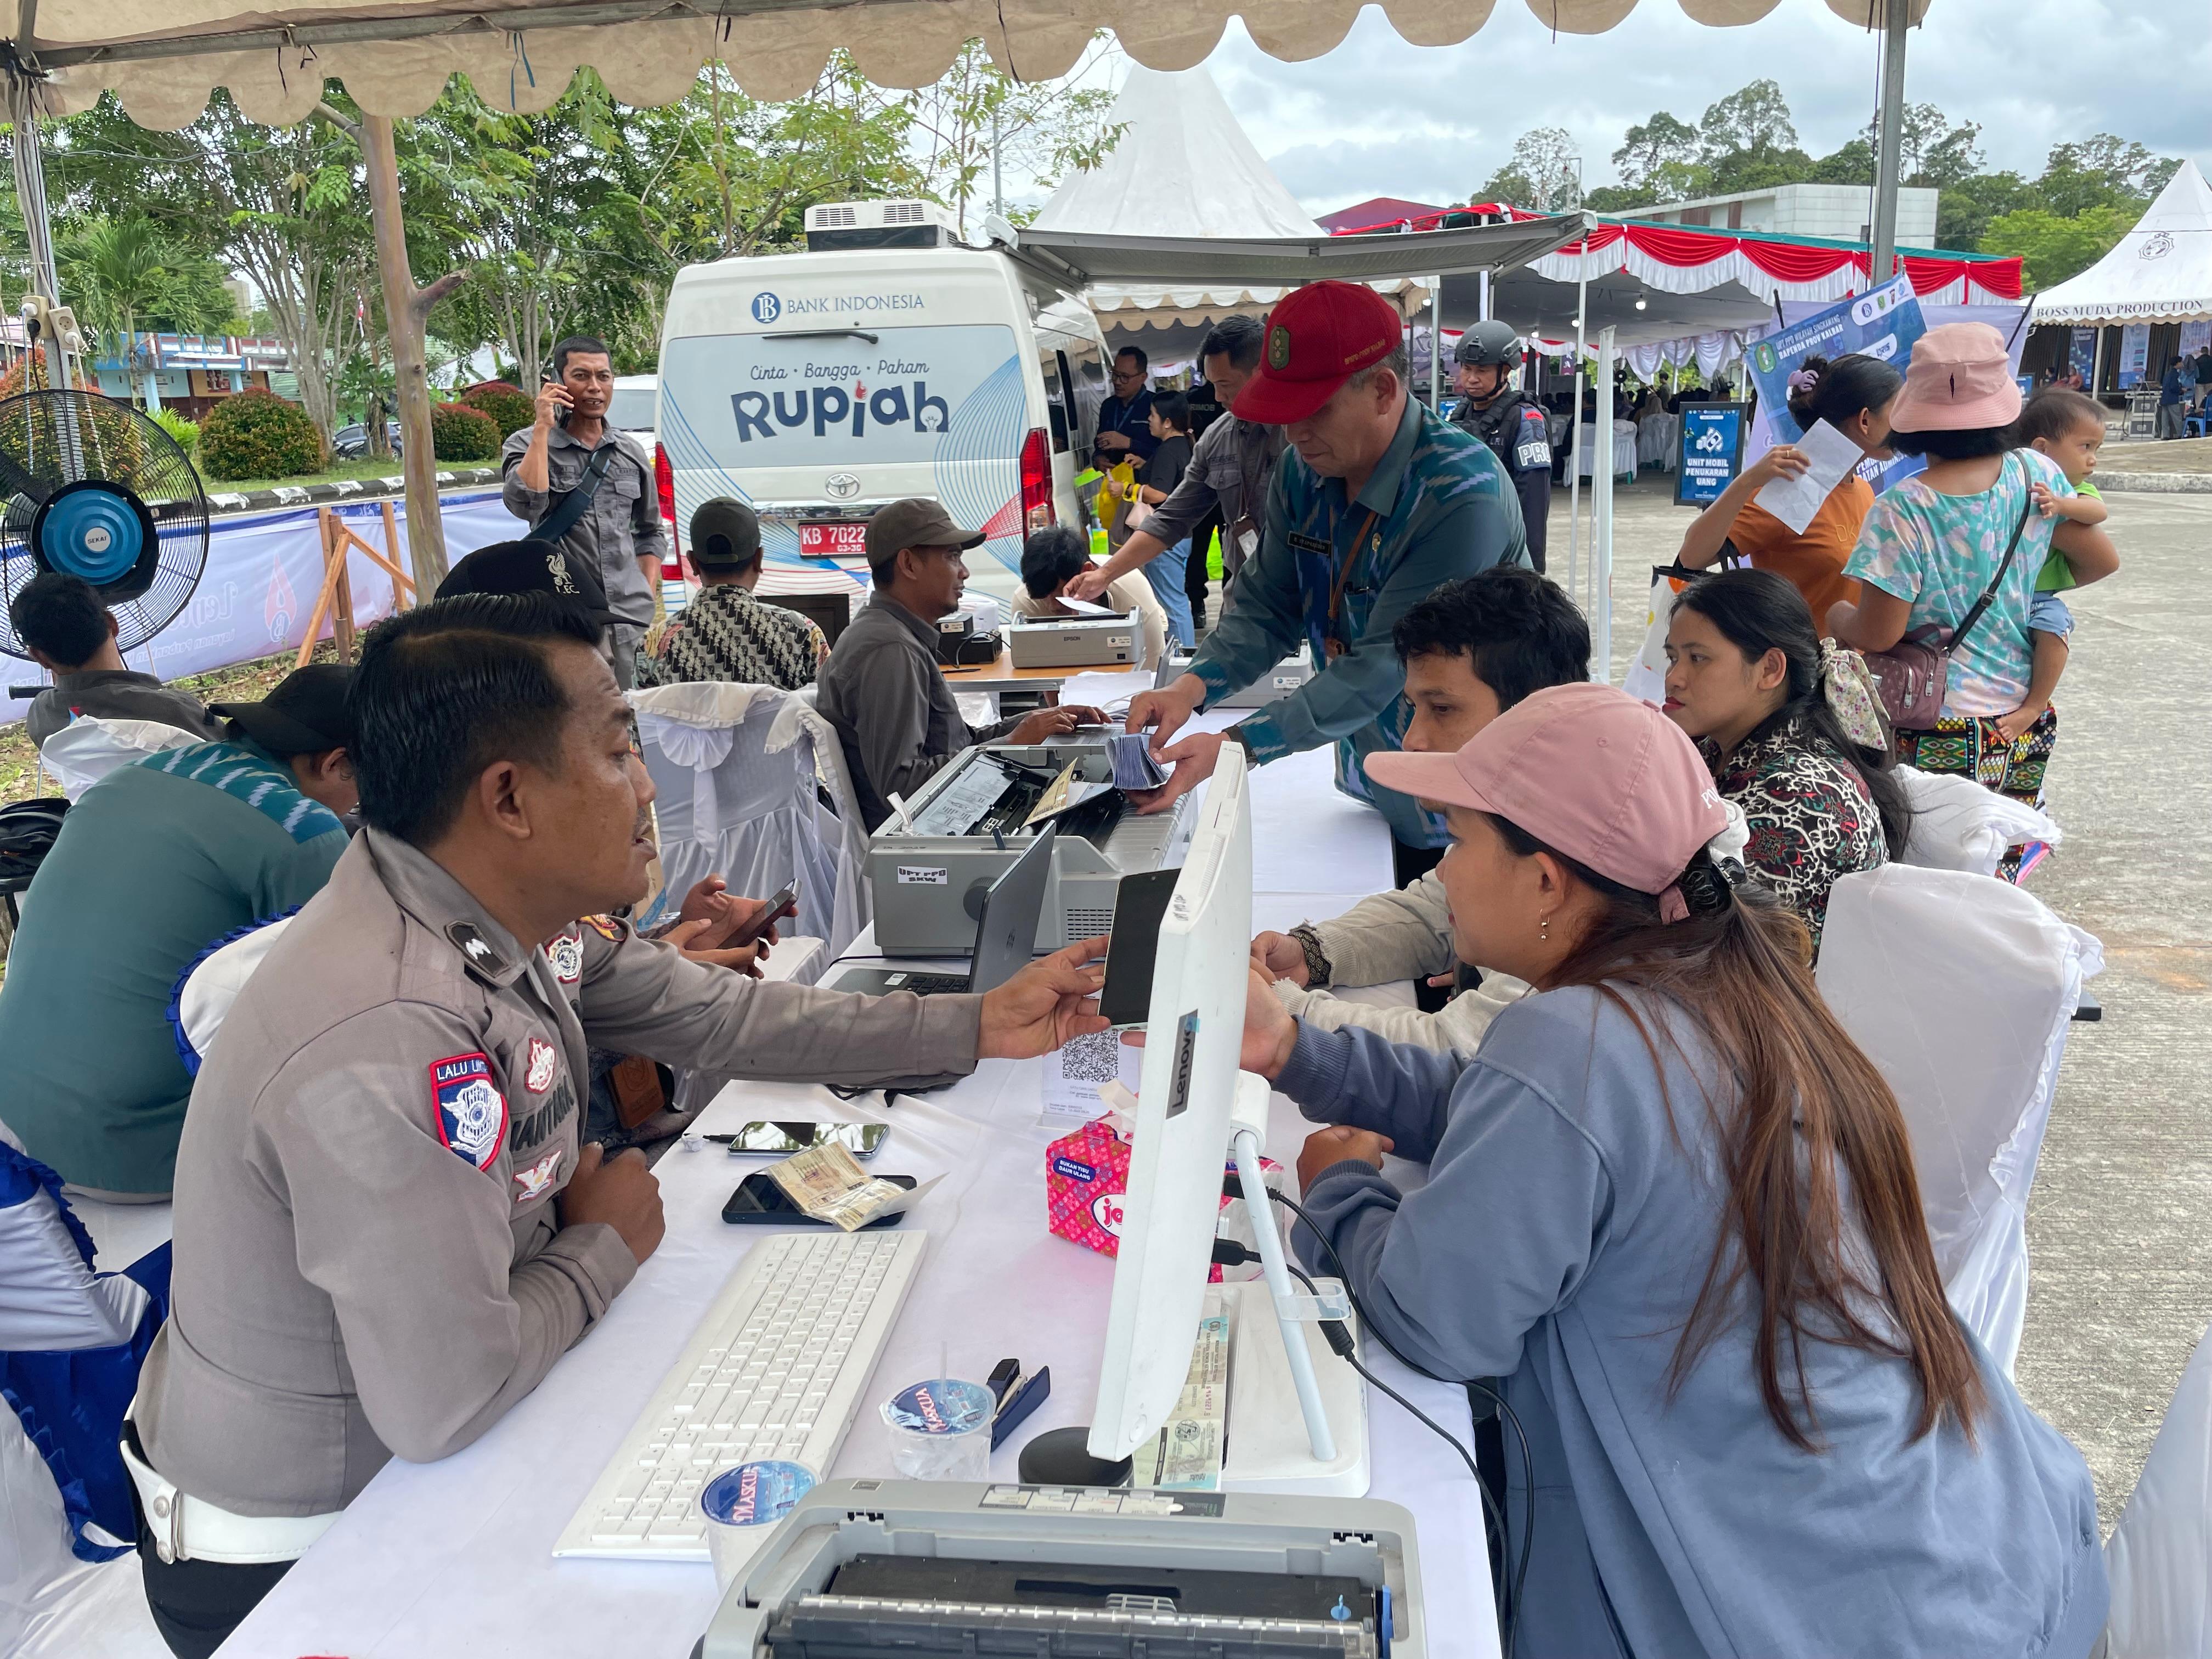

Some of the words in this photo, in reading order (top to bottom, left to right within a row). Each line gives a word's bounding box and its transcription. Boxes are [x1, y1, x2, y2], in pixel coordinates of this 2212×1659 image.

[787, 298, 829, 313] BANK
[835, 295, 925, 311] INDONESIA
[2037, 306, 2069, 317] BOSS
[2073, 305, 2111, 316] MUDA
[2117, 300, 2204, 314] PRODUCTION
[1778, 342, 1805, 360] BAPENDA
[1805, 334, 1821, 349] PROV
[1821, 324, 1844, 342] KALBAR
[751, 365, 788, 380] Cinta
[804, 363, 862, 381] Bangga
[878, 359, 930, 375] Paham
[730, 380, 950, 443] Rupiah
[1189, 403, 1215, 411] RIMOB
[1686, 458, 1705, 467] UNIT
[1705, 459, 1729, 467] MOBIL
[1685, 467, 1729, 477] PENUKARAN
[1696, 477, 1717, 486] UANG
[88, 536, 106, 544] SEKAI
[802, 527, 822, 544] KB
[828, 526, 866, 544] 7022
[899, 867, 921, 876] UPT
[437, 1060, 467, 1080] LALU
[1058, 1165, 1073, 1175] DAUR
[1073, 1171, 1091, 1181] ULANG
[1059, 1160, 1077, 1170] BUKAN
[1077, 1165, 1090, 1174] TISU
